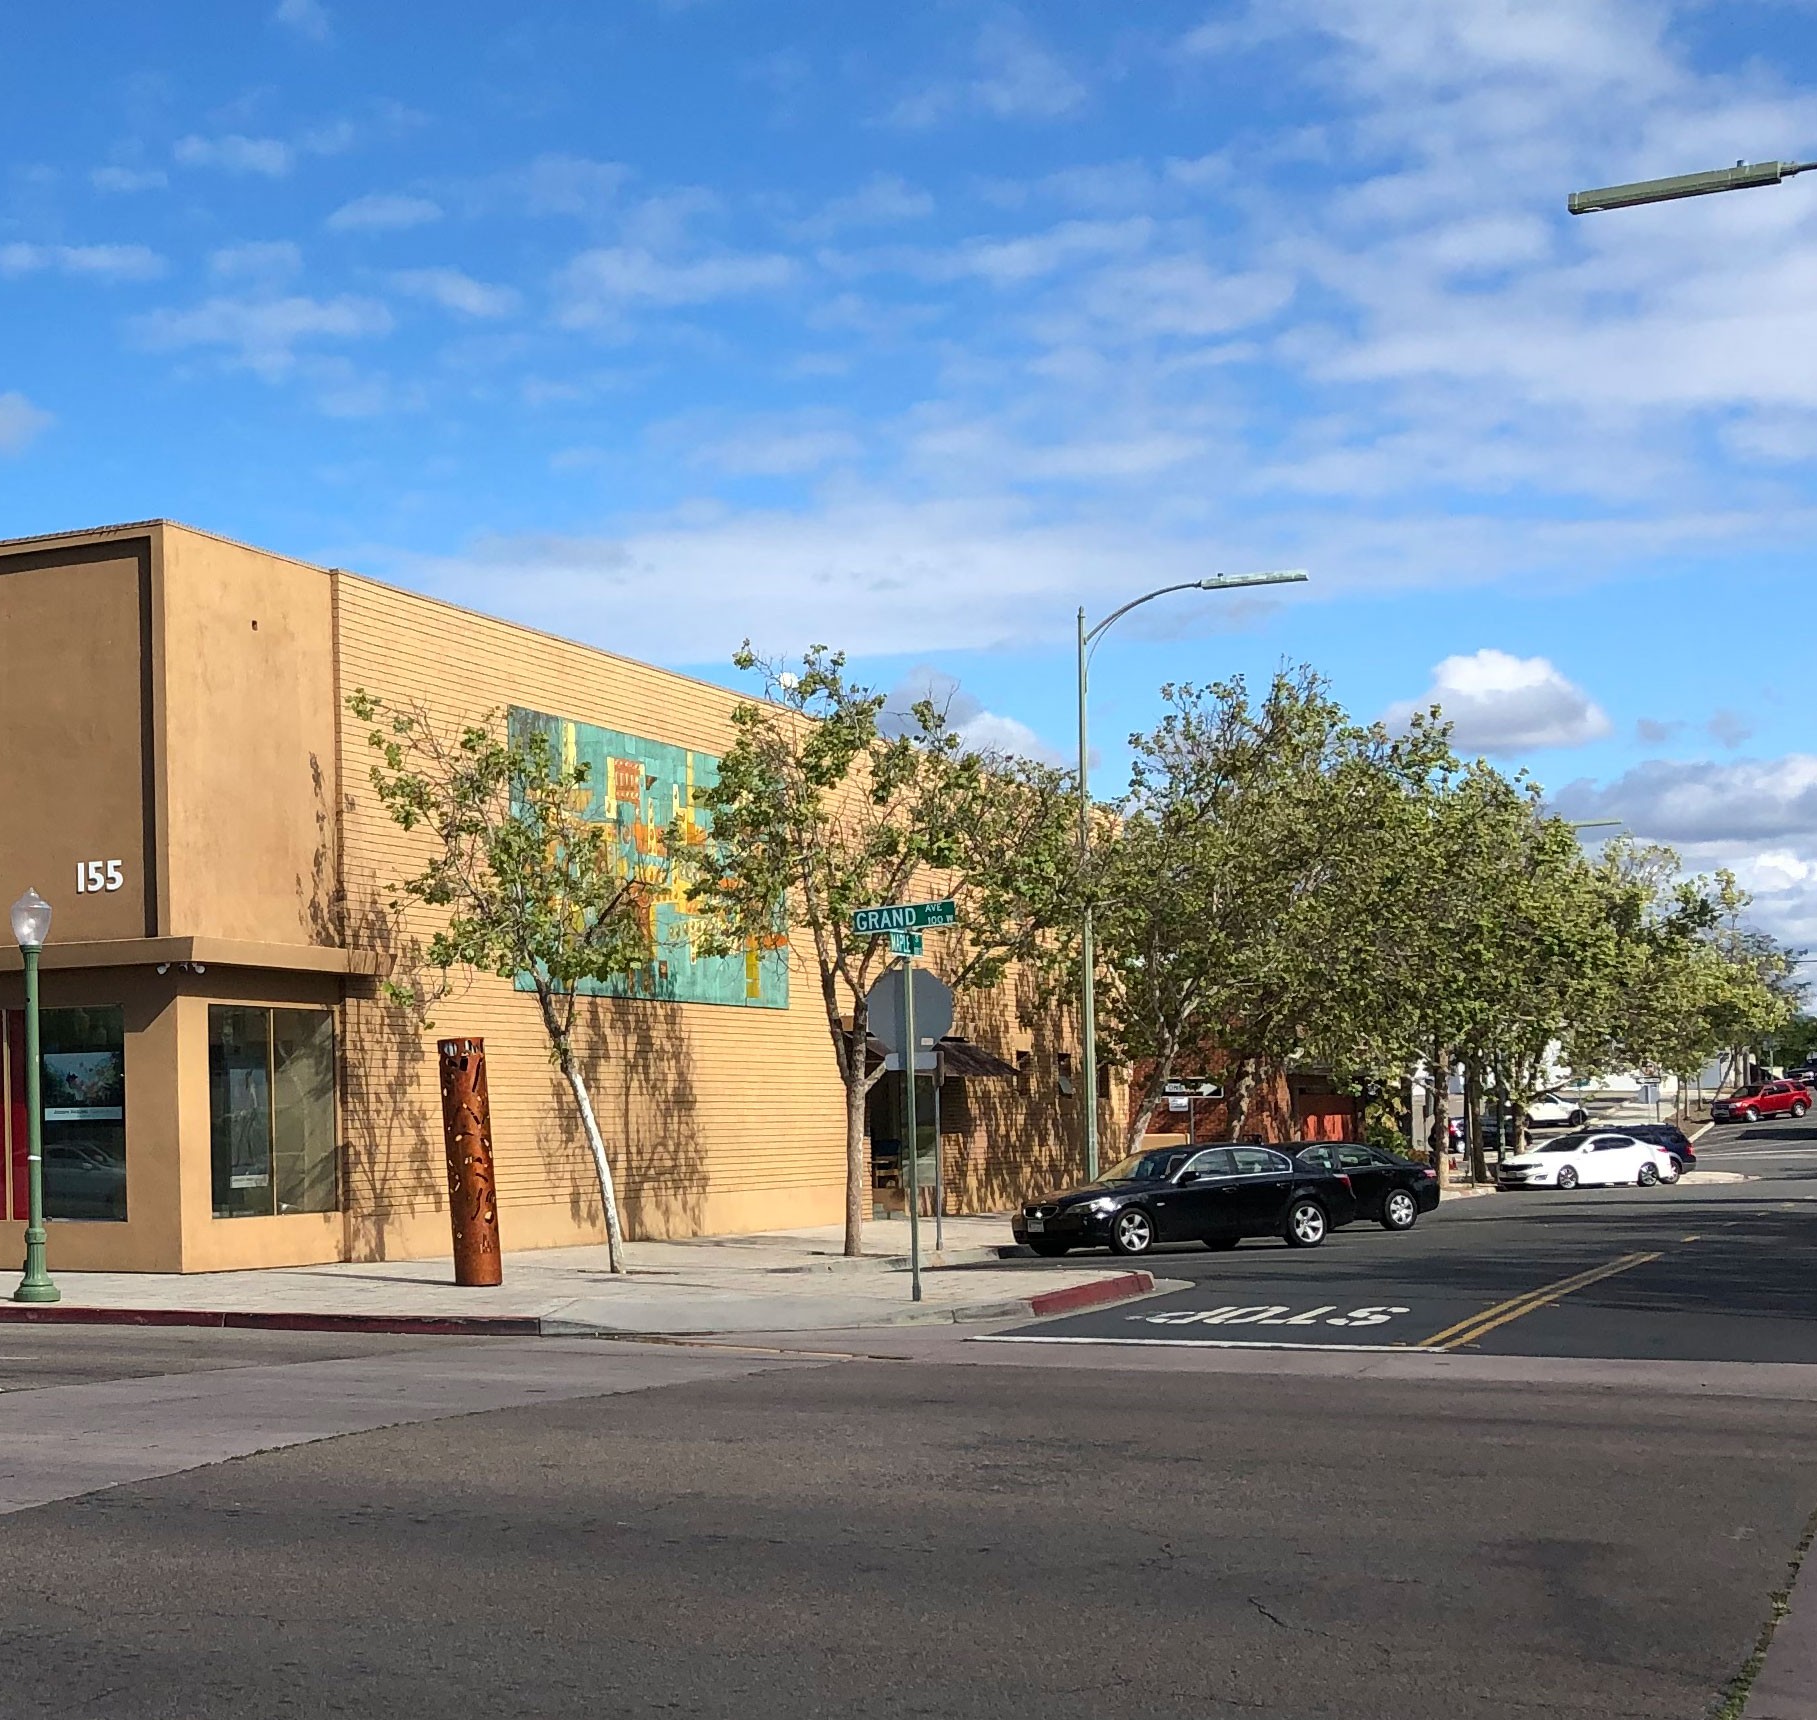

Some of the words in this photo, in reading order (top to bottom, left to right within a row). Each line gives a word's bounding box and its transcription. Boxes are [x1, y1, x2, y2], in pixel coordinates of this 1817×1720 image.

[77, 860, 124, 892] 155
[856, 907, 917, 931] GRAND
[925, 903, 943, 912] AVE
[927, 915, 944, 924] 100
[946, 914, 954, 923] W
[890, 932, 911, 953] MAPLE
[1145, 1305, 1411, 1327] STOP
